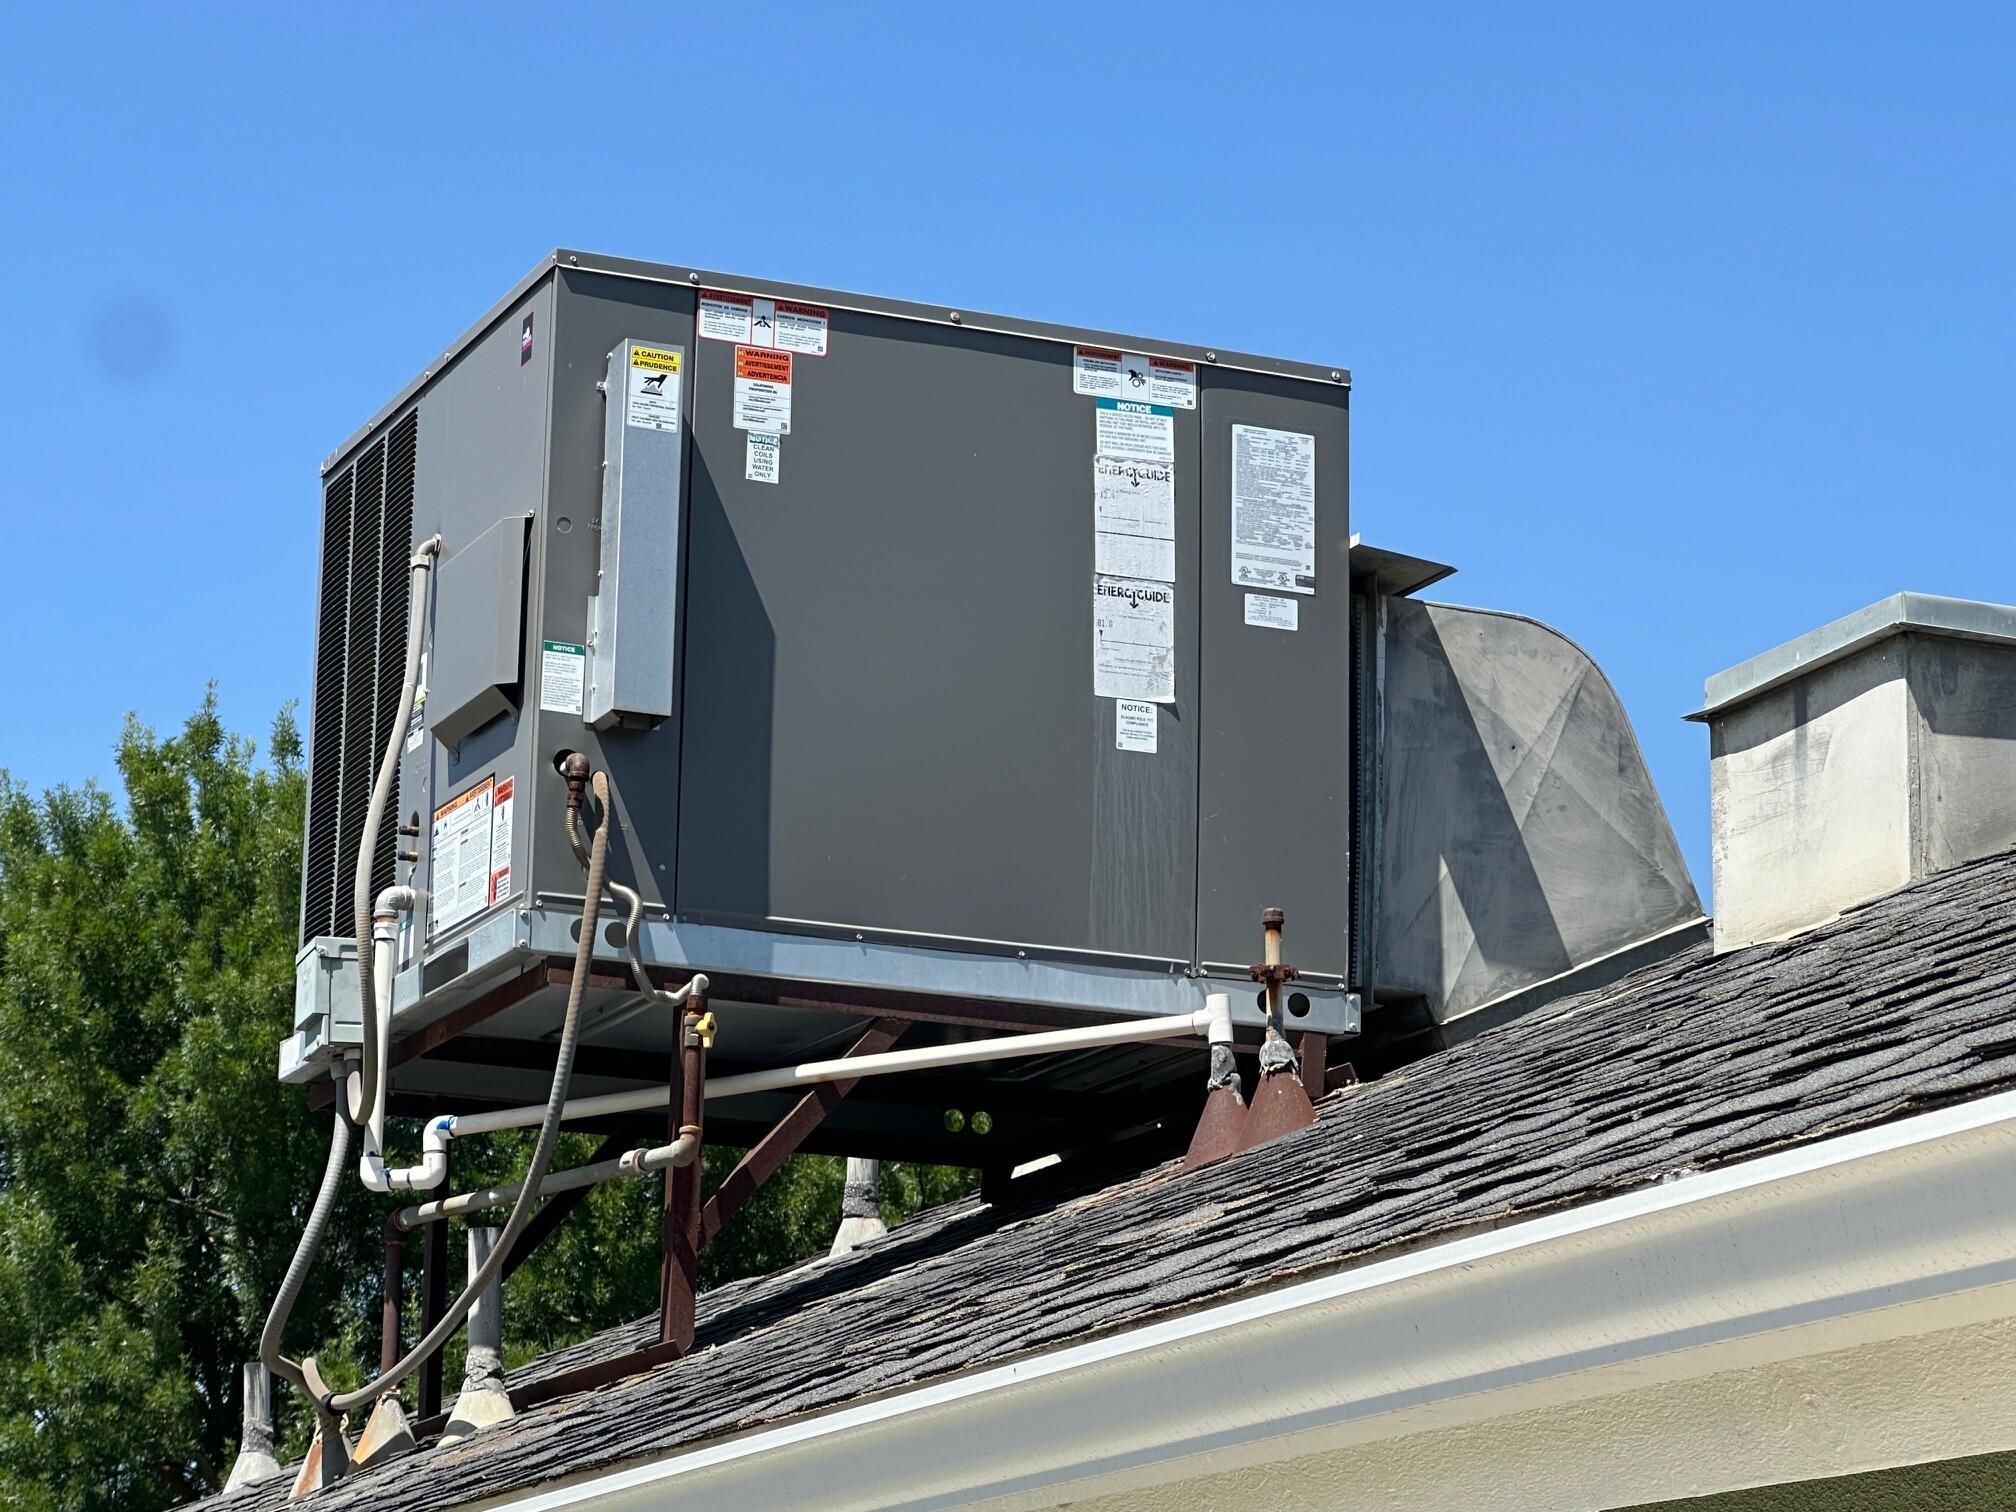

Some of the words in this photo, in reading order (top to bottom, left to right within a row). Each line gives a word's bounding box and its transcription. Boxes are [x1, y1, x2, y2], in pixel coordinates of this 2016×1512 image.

[785, 305, 826, 318] WARNING
[641, 351, 674, 361] CAUTION
[745, 350, 789, 361] WARNING
[640, 360, 677, 372] PRUDENCE
[744, 359, 789, 371] AVERTISSEMENT
[746, 370, 788, 382] ADVERTENCIA
[1116, 402, 1152, 414] NOTICE
[753, 444, 775, 452] CLEAN
[753, 451, 773, 459] COILS
[753, 457, 773, 465] USING
[751, 464, 774, 472] WATER
[754, 471, 771, 479] ONLY
[1097, 618, 1113, 628] 81.0
[552, 644, 576, 653] NOTICE
